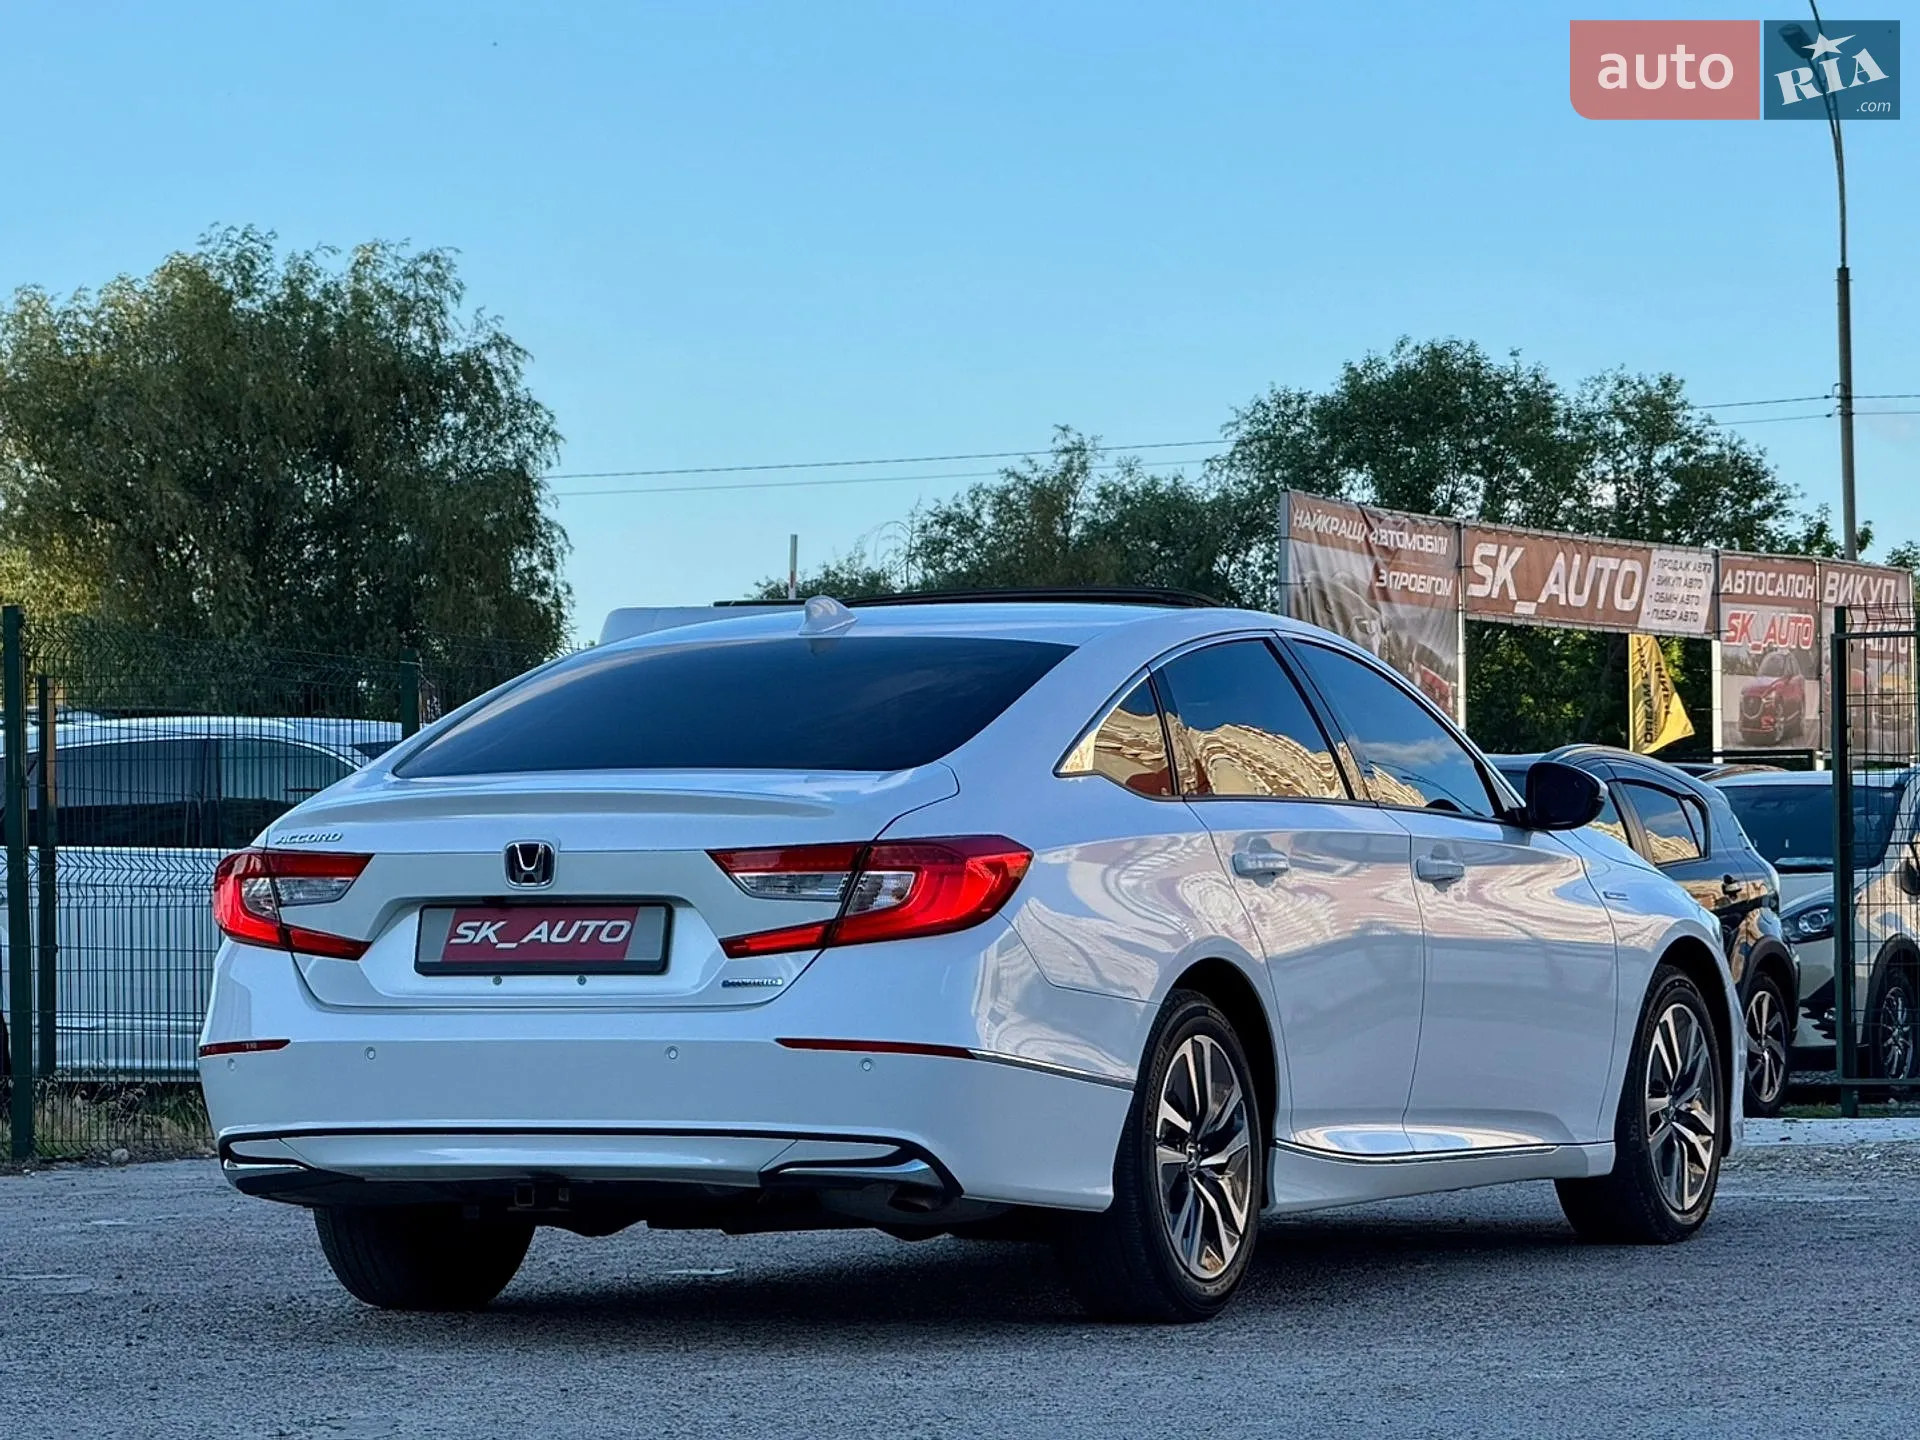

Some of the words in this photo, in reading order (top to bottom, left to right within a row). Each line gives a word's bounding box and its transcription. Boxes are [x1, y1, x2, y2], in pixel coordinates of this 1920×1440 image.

[1388, 569, 1454, 597] ПРОБІГОМ
[1467, 542, 1643, 615] SK_AUTO
[1721, 568, 1816, 600] АВТОСАЛОН
[1824, 571, 1896, 609] ВИКУП
[1723, 609, 1815, 654] SK_AUTO
[274, 831, 343, 845] ACCORD
[450, 920, 632, 949] SK_AUTO
